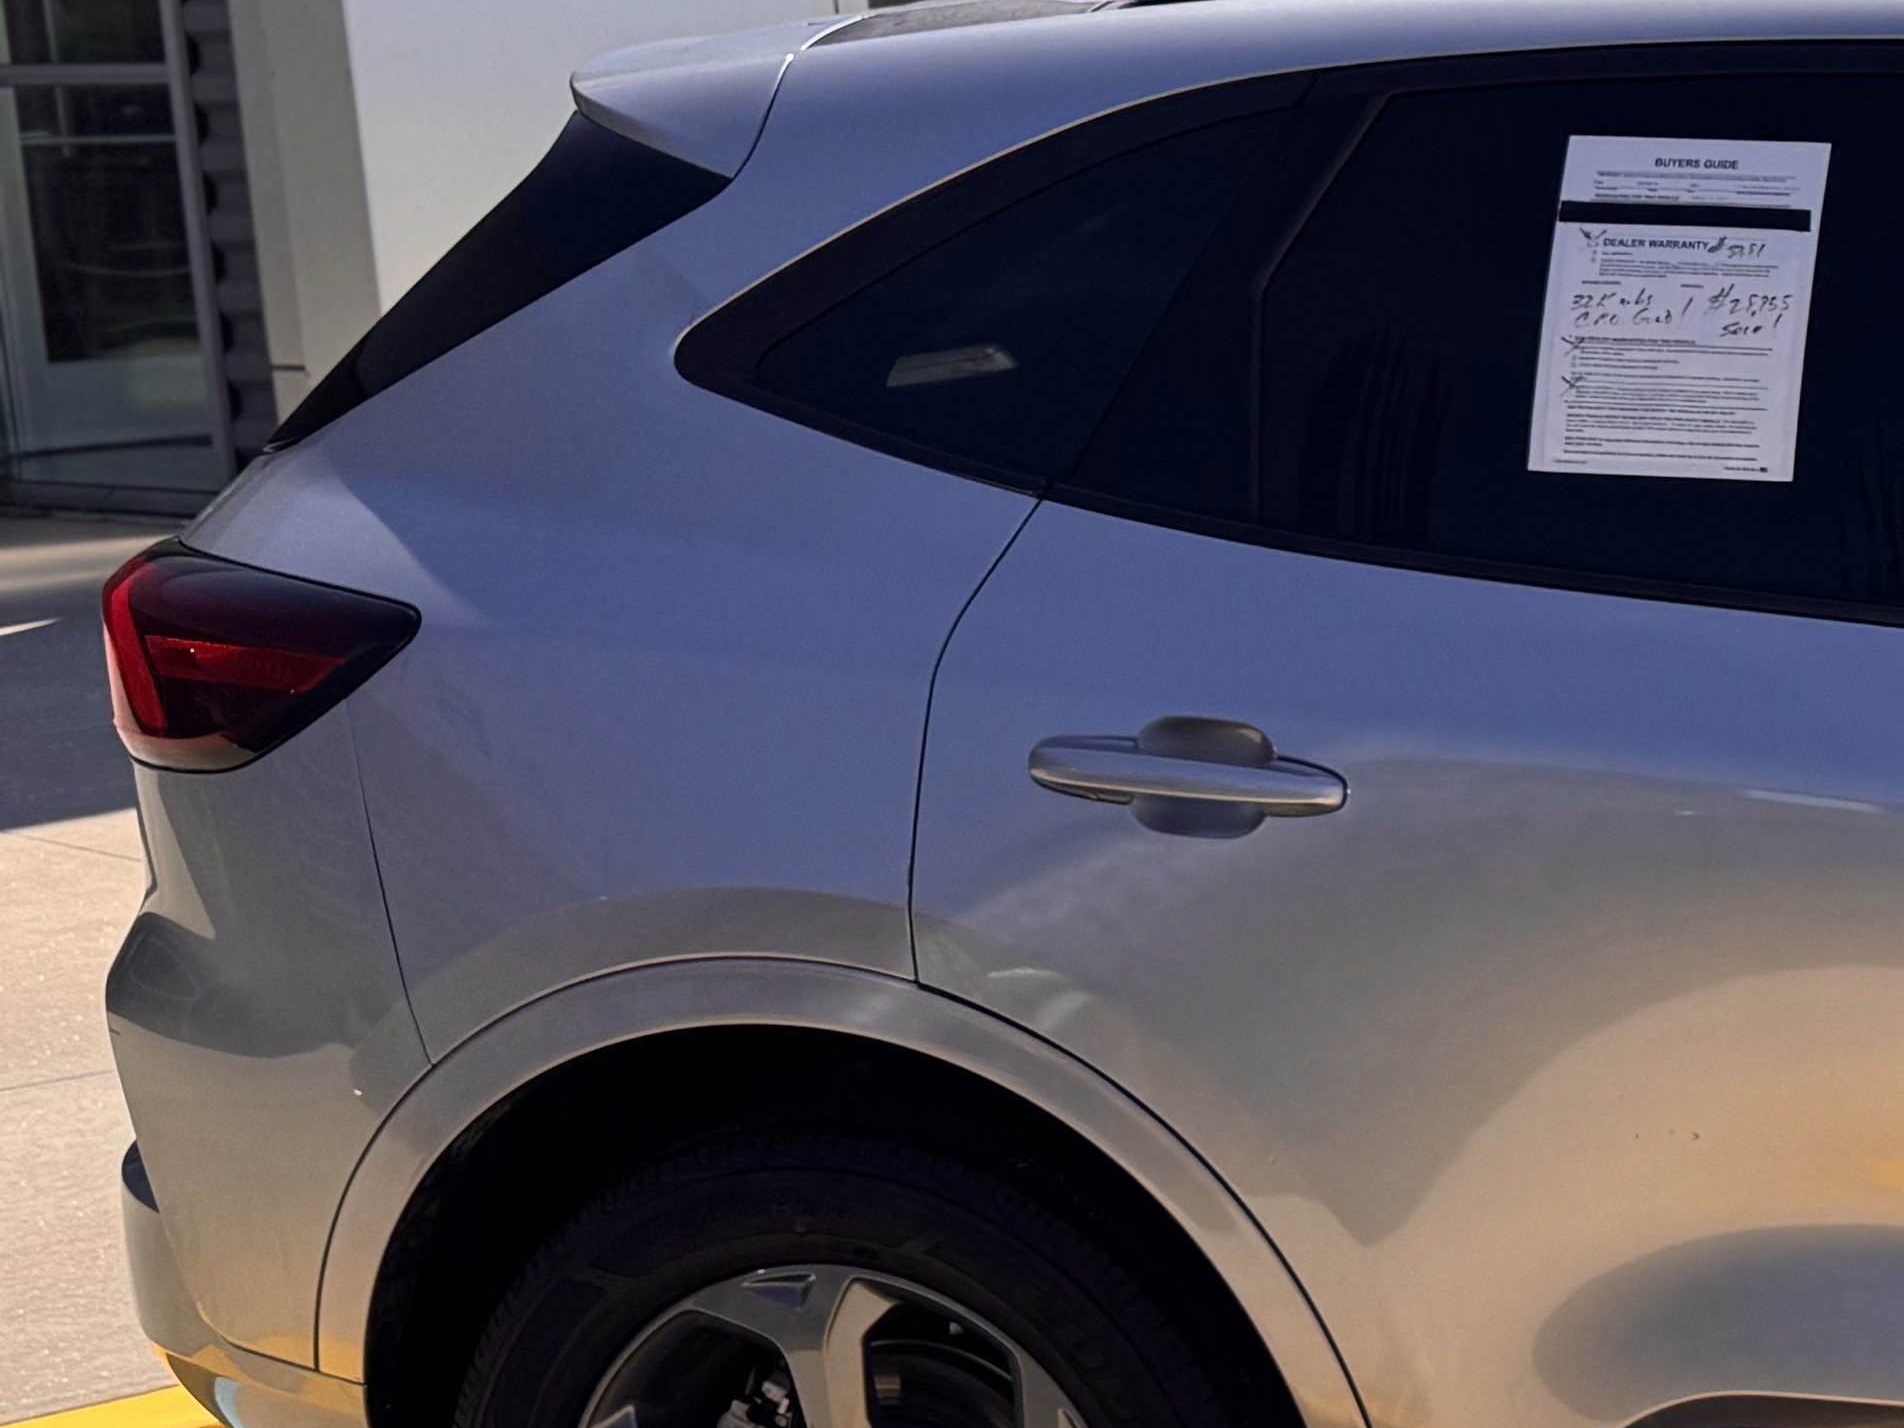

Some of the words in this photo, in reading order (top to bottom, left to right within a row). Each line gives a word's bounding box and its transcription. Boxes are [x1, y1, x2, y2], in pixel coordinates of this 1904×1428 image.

[1654, 157, 1700, 169] BUYERS
[1704, 159, 1739, 170] GUIDE
[1603, 237, 1646, 249] DEALER
[1649, 238, 1709, 251] WARRANTY
